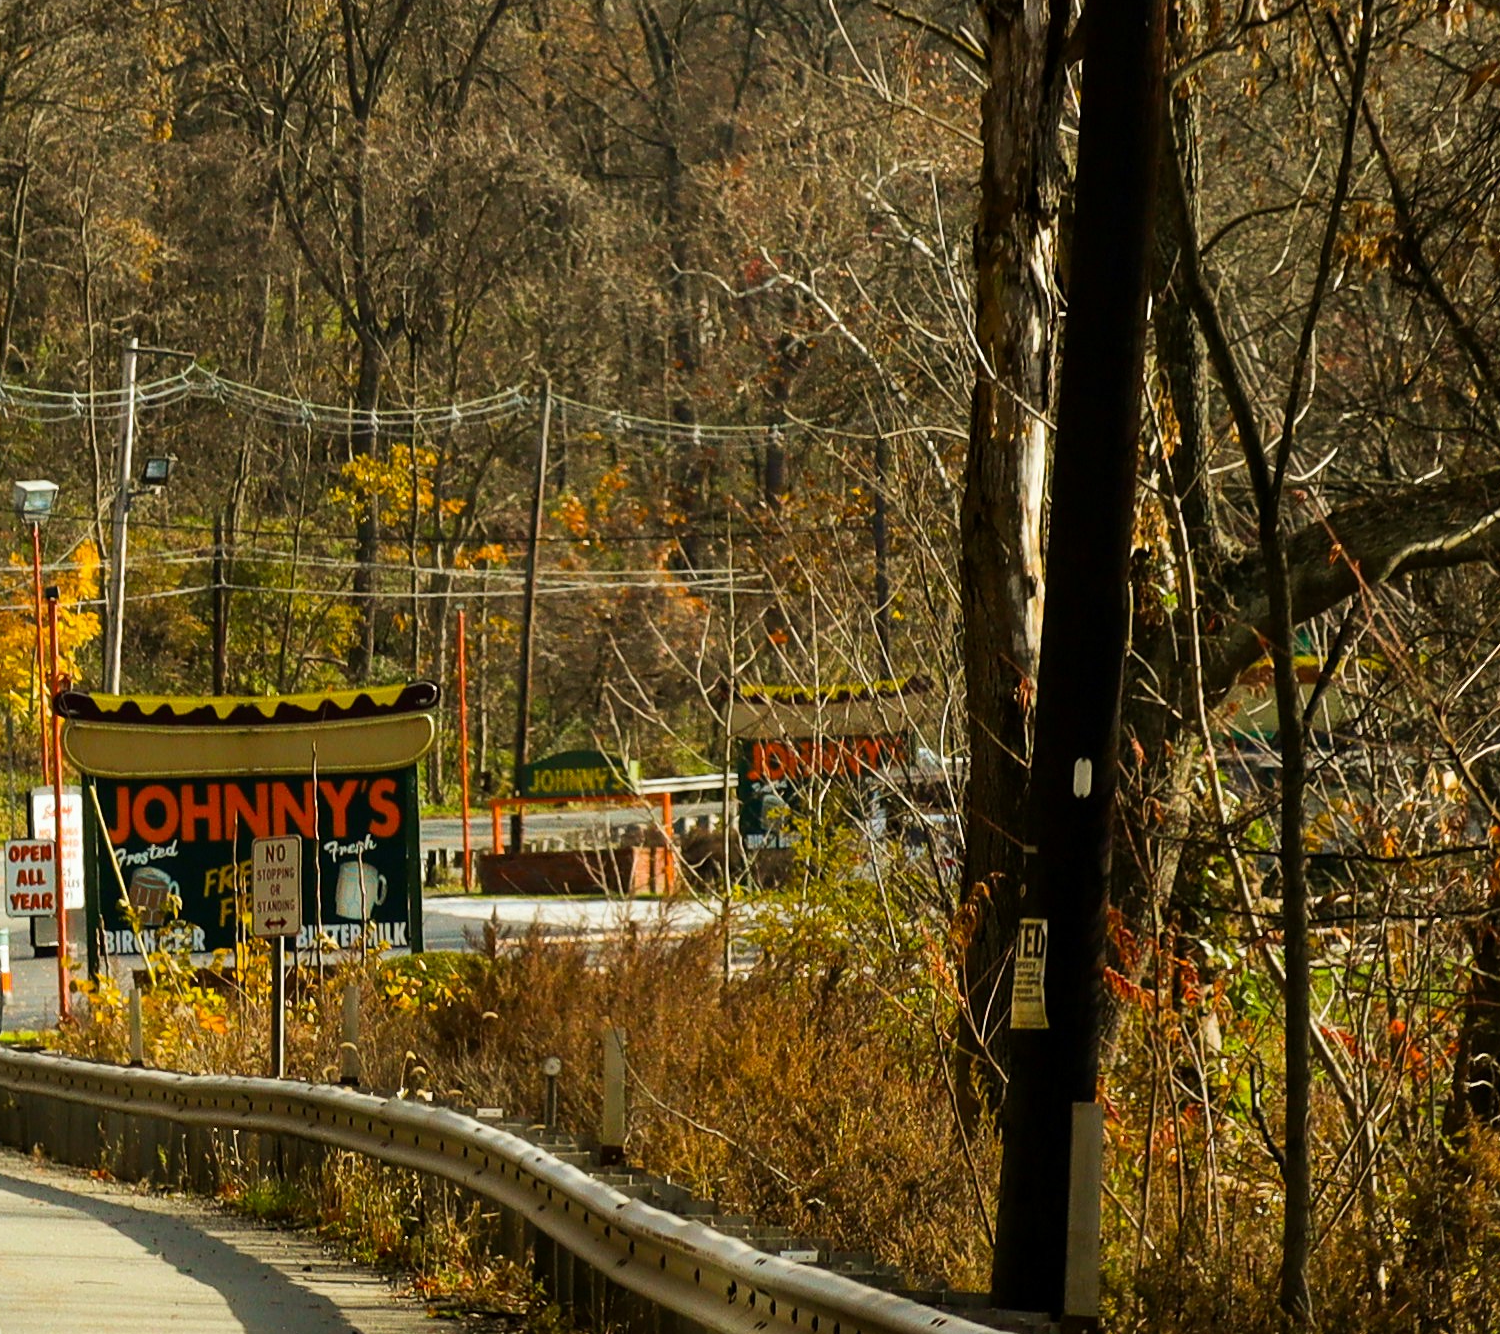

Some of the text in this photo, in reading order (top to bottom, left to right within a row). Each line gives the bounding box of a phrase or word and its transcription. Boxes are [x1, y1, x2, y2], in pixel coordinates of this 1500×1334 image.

[108, 778, 402, 845] JOHNNY'S
[8, 845, 52, 863] OPEN
[114, 839, 179, 867] Frosted
[265, 844, 286, 863] NO
[16, 868, 47, 887] ALL
[257, 867, 295, 881] STOPPING
[270, 884, 280, 897] OR
[10, 892, 53, 910] YEAR
[257, 899, 296, 914] STANDING
